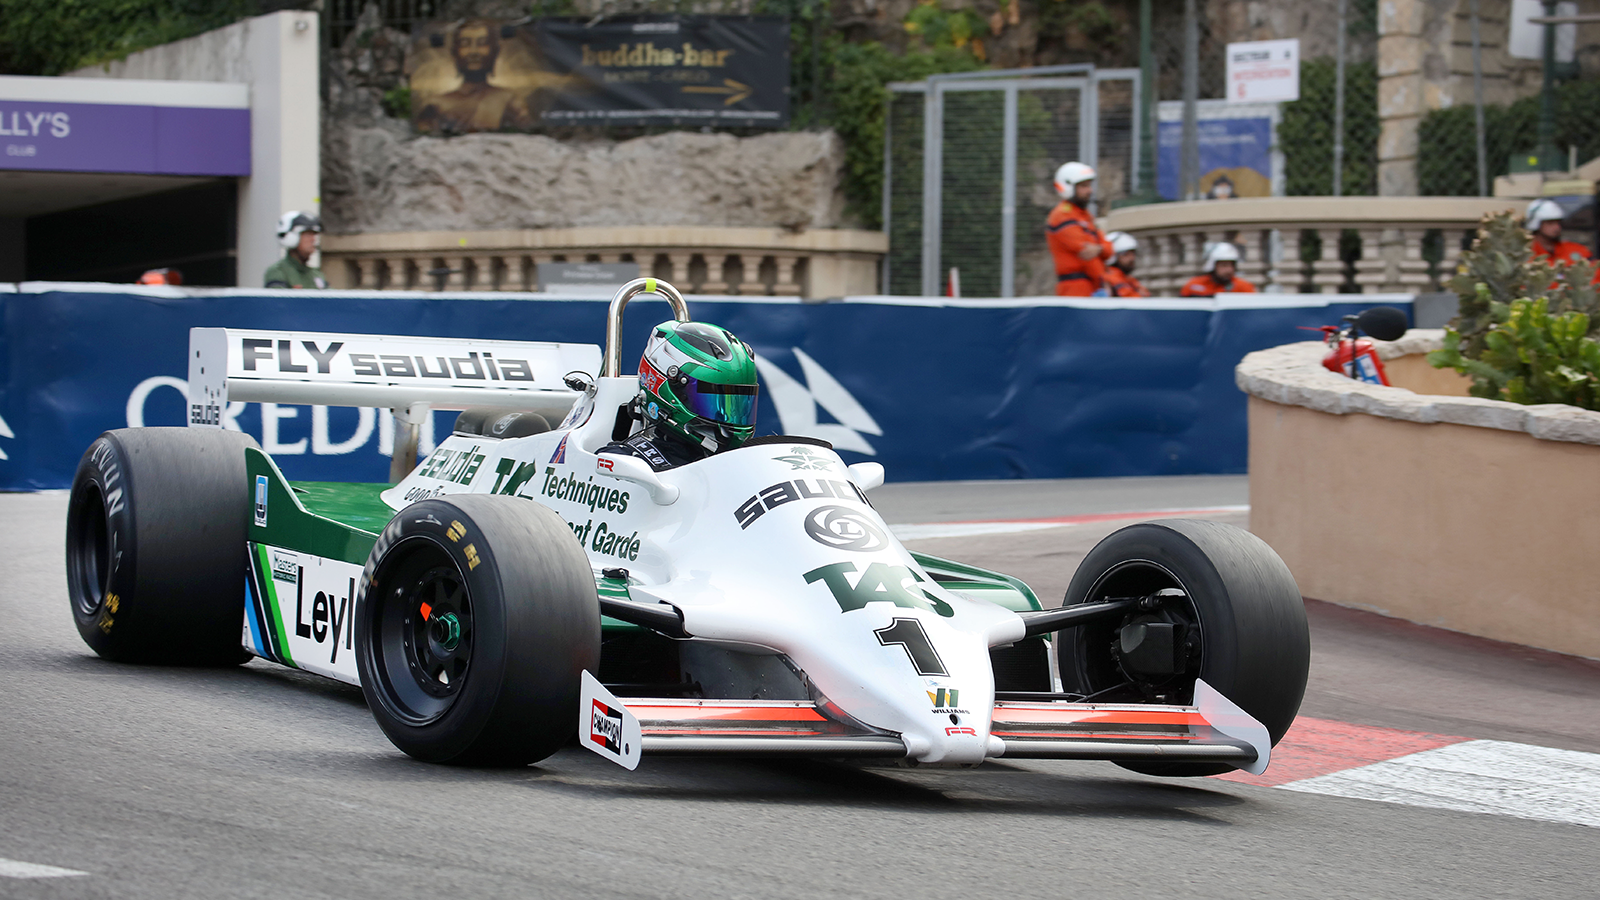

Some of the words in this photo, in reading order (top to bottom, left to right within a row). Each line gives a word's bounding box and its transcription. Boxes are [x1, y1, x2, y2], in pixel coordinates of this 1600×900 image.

[582, 42, 734, 66] buddha-bar
[242, 338, 344, 374] FLY
[349, 352, 534, 382] saudia
[541, 466, 630, 514] Techniques
[592, 522, 641, 561] Garde
[296, 566, 355, 665] Leyl
[873, 617, 950, 678] 1
